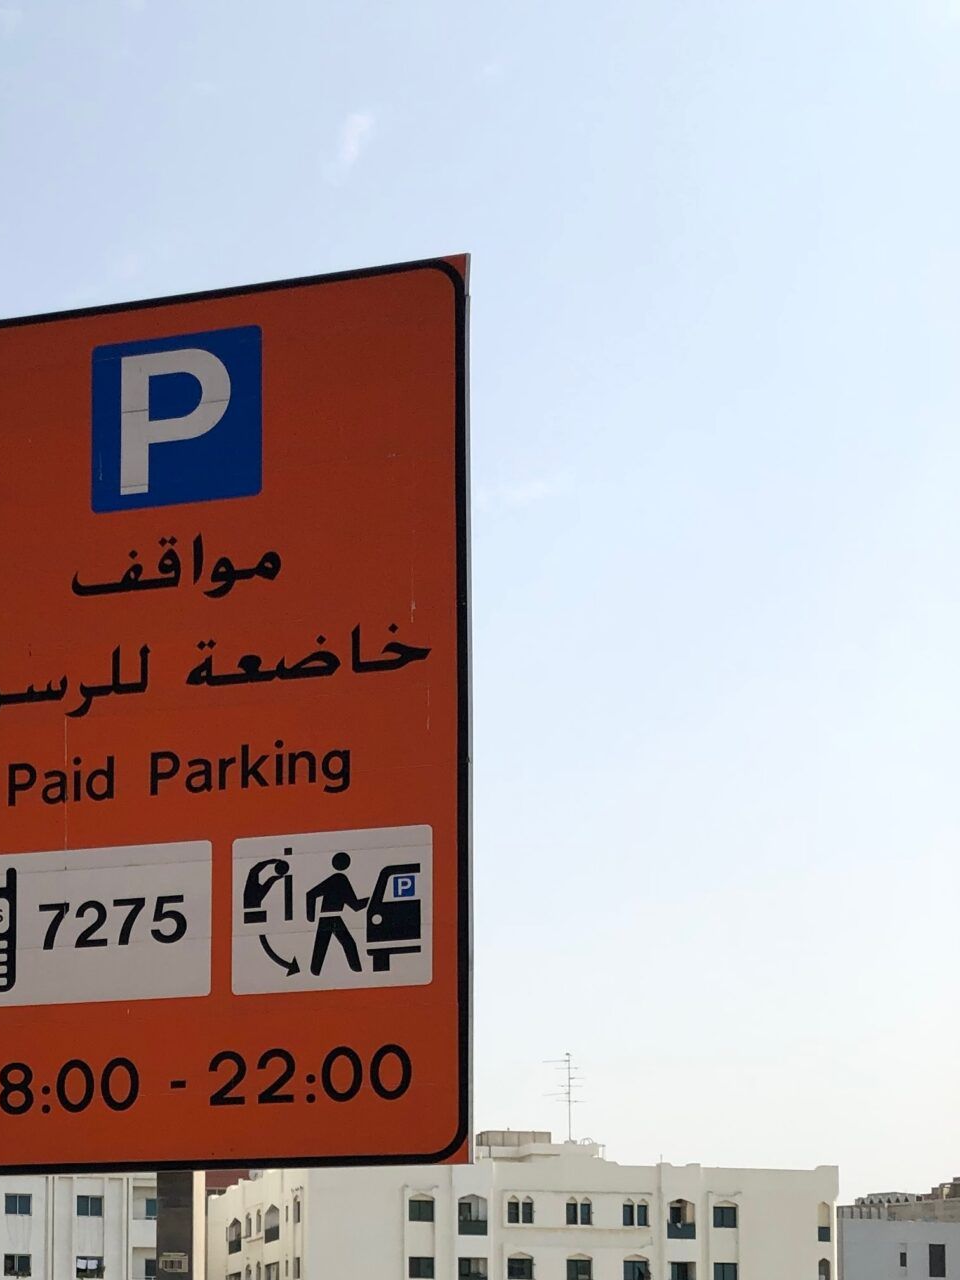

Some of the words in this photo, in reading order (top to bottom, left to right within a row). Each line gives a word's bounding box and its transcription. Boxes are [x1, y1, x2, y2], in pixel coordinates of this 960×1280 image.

[120, 347, 231, 496] P
[71, 534, 281, 598] مواقف
[185, 623, 432, 686] خاضعة
[7, 757, 115, 806] Paid
[150, 740, 351, 796] Parking
[398, 879, 412, 895] P
[38, 894, 188, 950] 7275
[208, 1043, 412, 1106] 22:00
